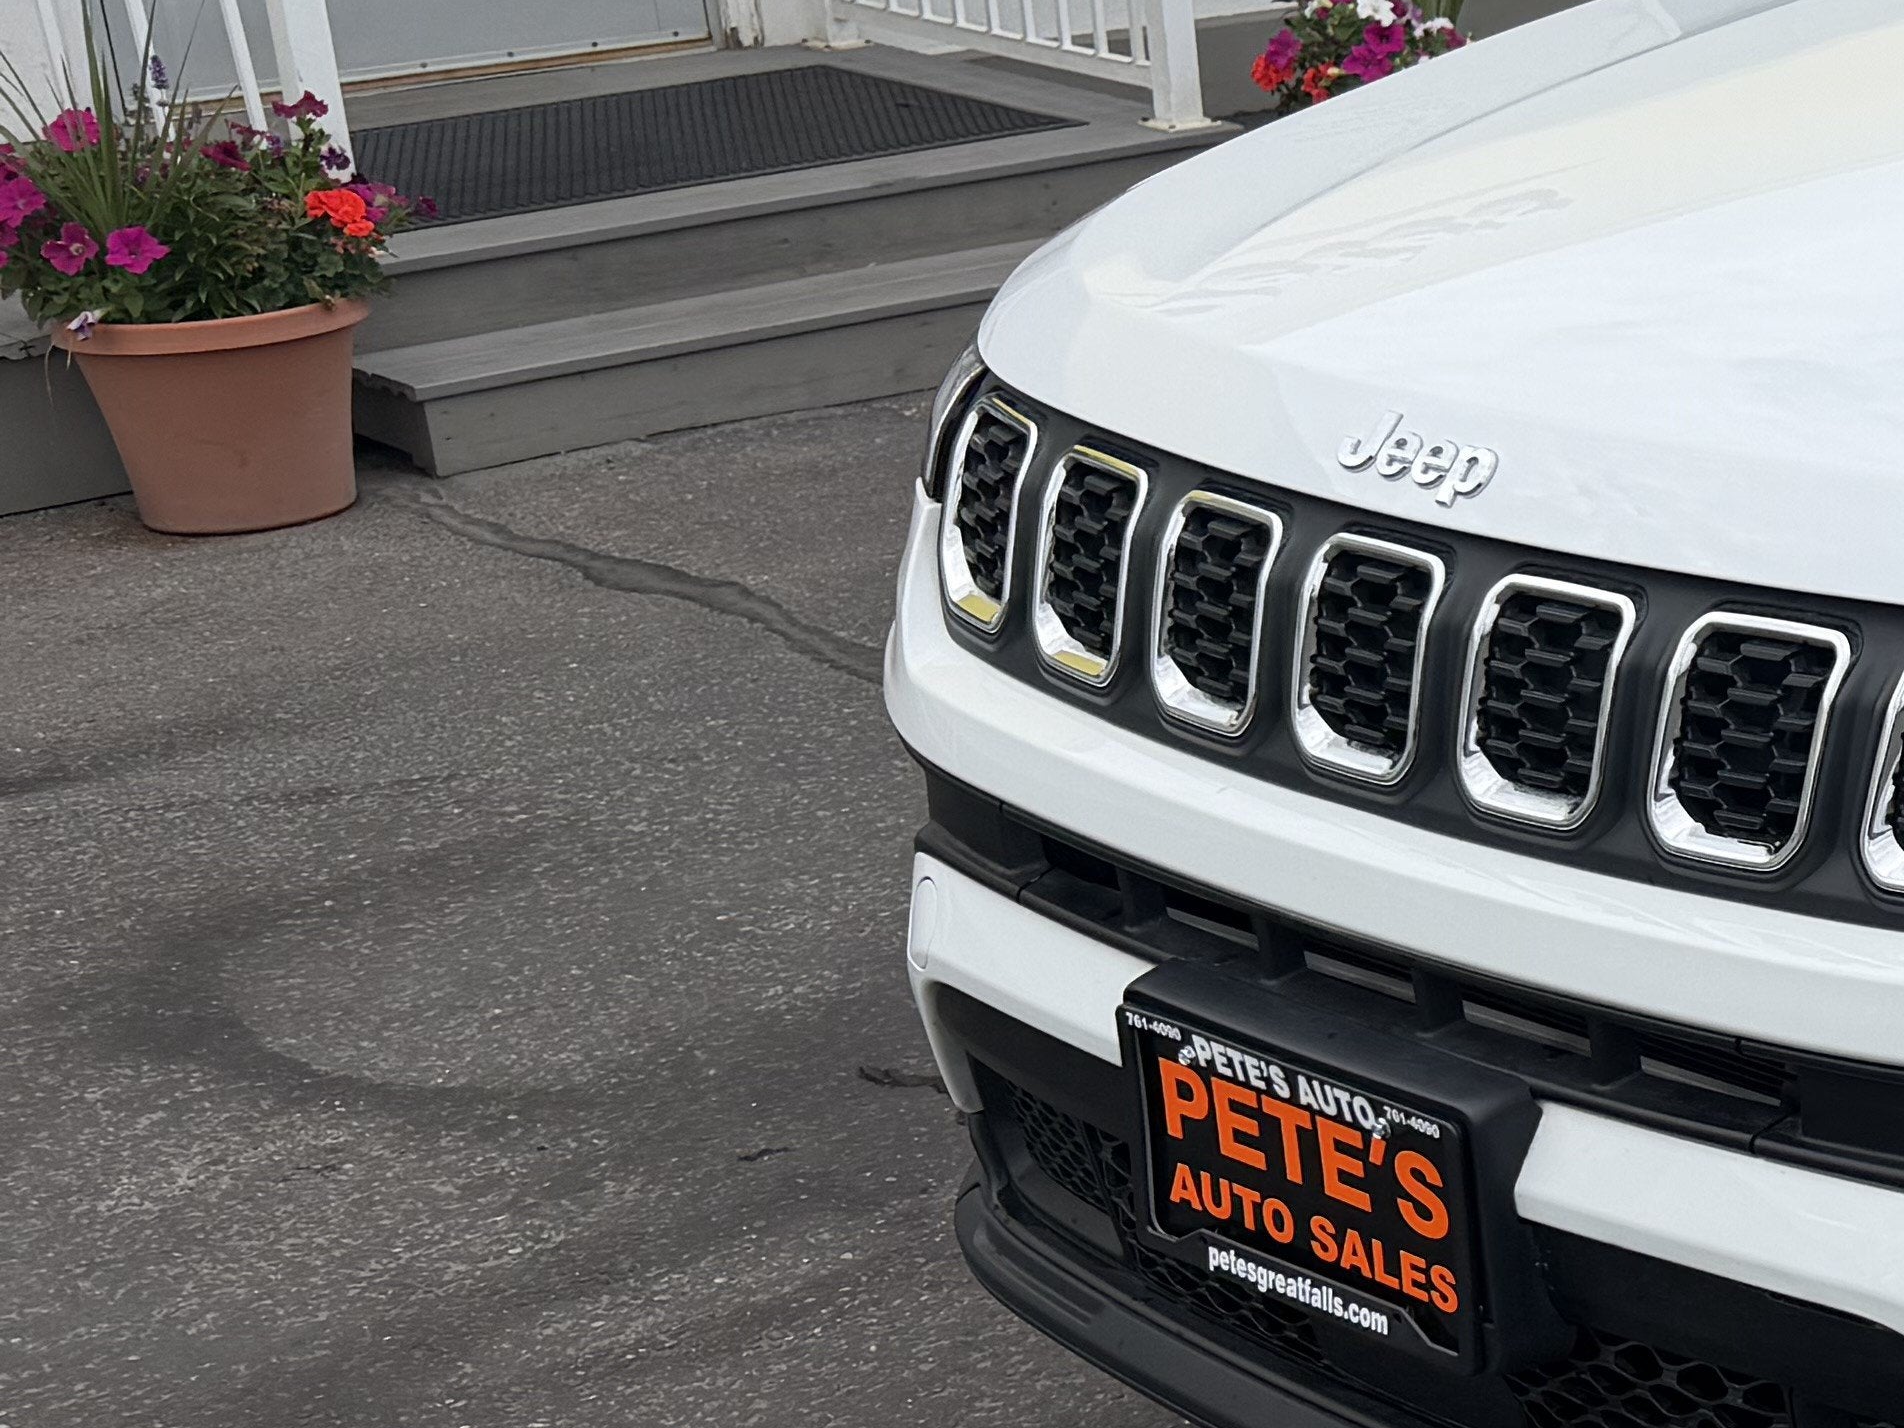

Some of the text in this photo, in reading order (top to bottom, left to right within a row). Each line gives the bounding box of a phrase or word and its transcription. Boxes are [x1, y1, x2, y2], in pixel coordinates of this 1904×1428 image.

[1336, 410, 1500, 510] Jeep
[1191, 1034, 1375, 1131] PETE'S AUTO
[1157, 1056, 1450, 1240] PETE'S
[1169, 1162, 1459, 1314] AUTO SALES
[1207, 1245, 1390, 1336] petesgreatfalls.com
